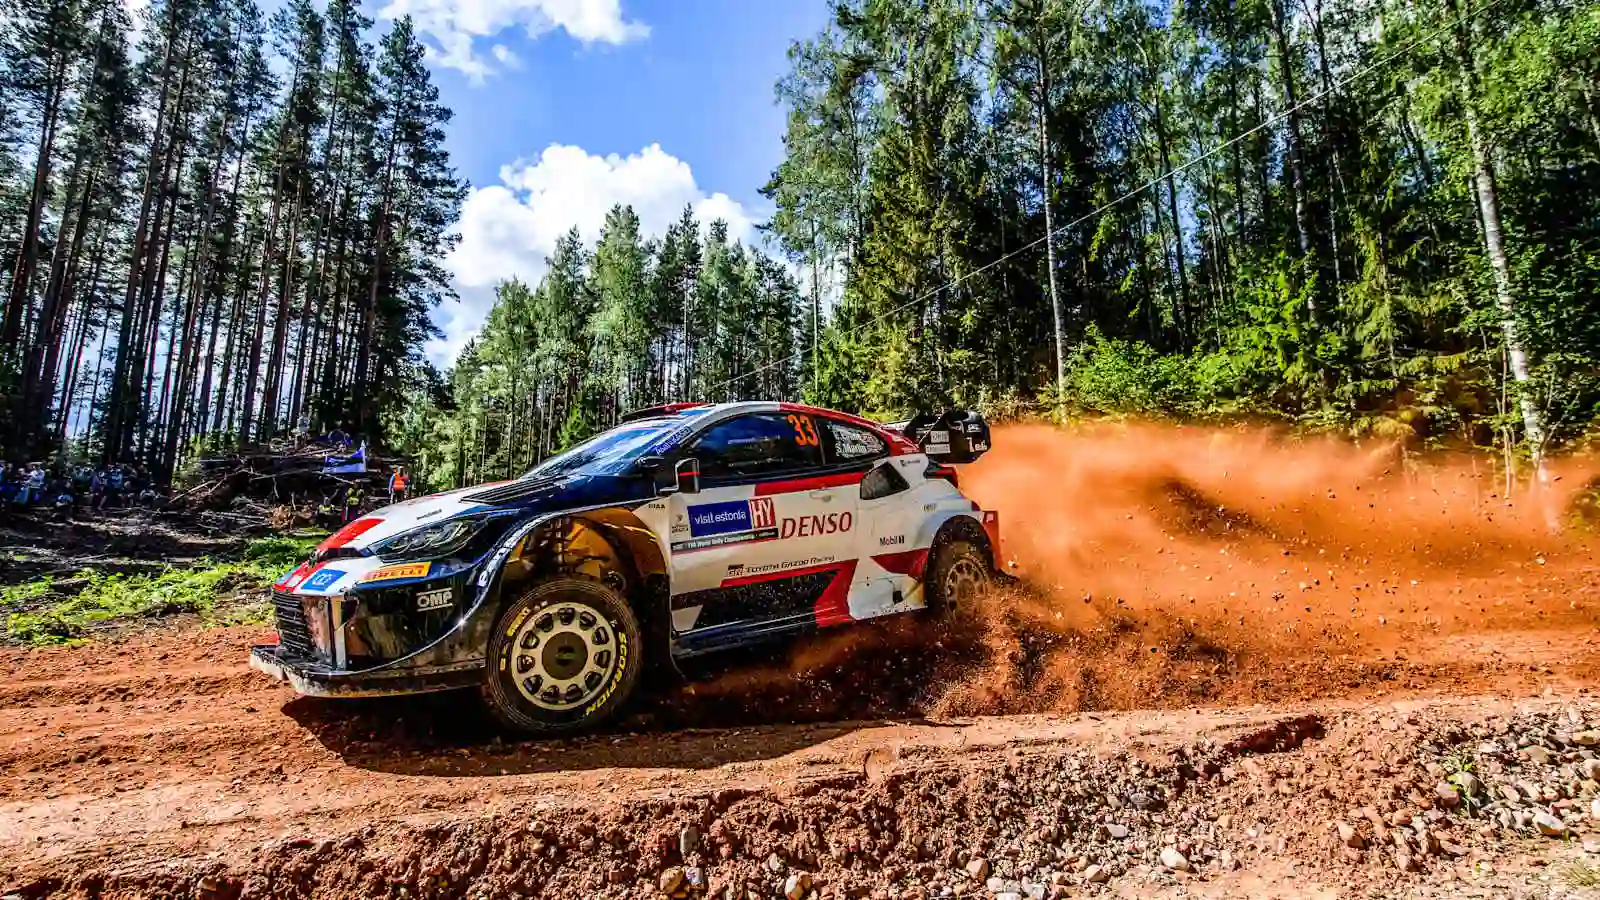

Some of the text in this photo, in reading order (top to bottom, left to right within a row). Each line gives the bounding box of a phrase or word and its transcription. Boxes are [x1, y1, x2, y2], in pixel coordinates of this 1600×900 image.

[787, 414, 818, 447] 33
[694, 510, 747, 525] visit estonia
[780, 511, 852, 539] DENSO
[879, 536, 898, 547] Mobil
[417, 591, 452, 607] OMP
[586, 632, 627, 715] SCORPION
